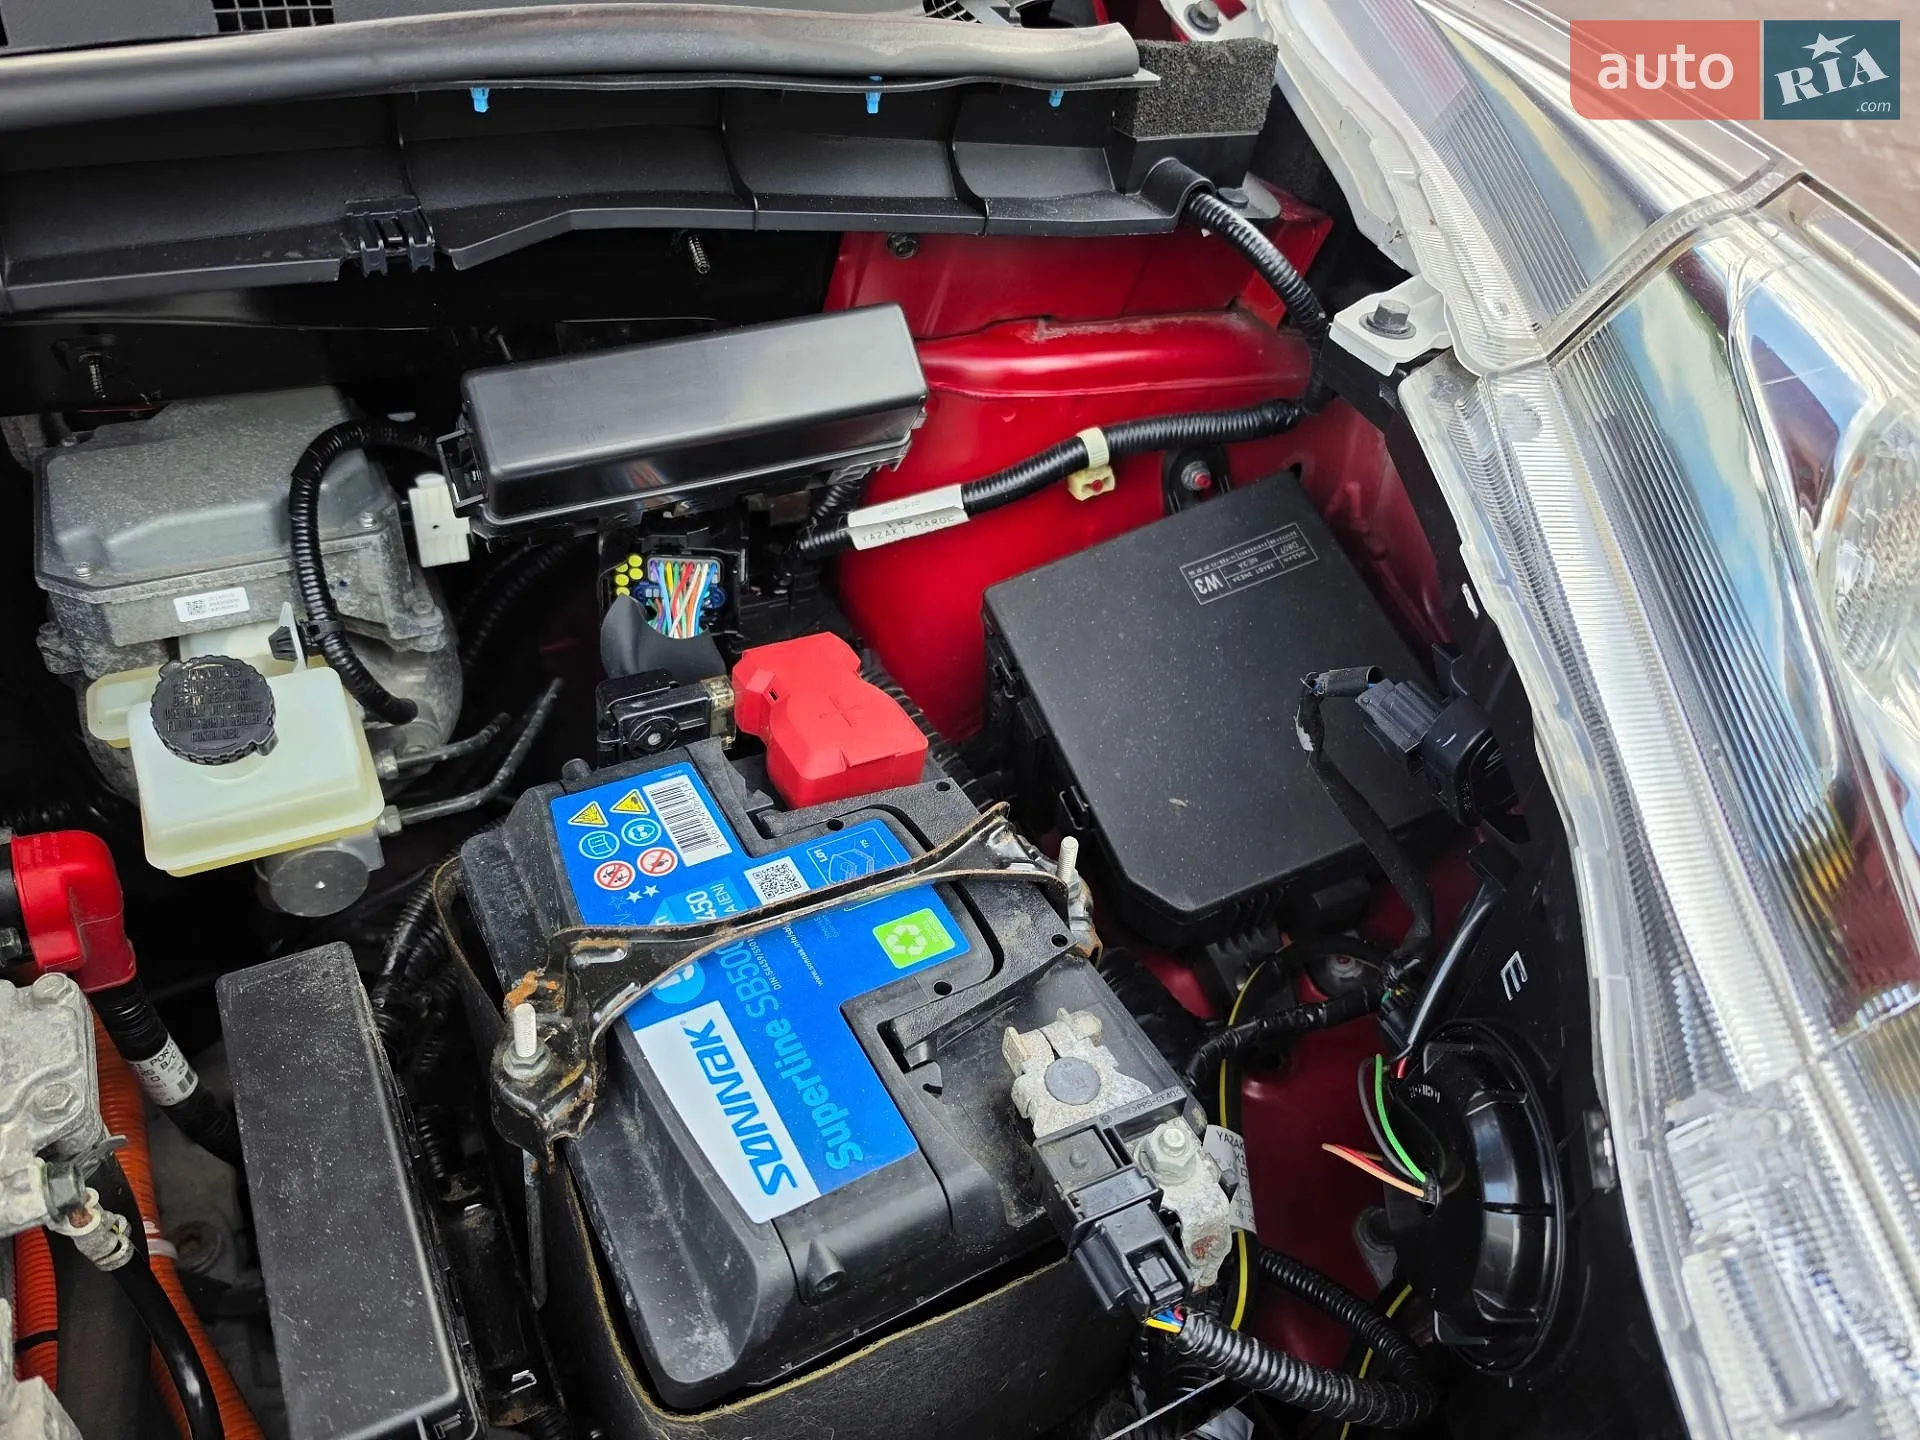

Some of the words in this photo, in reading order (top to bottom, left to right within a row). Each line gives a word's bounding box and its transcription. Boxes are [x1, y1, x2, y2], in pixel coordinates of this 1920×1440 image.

[861, 526, 907, 543] YAZAKI
[914, 514, 955, 530] MAROC
[1194, 572, 1223, 594] W3
[685, 891, 718, 921] 450
[783, 924, 824, 988] www.sonnak.info/sb
[765, 1017, 864, 1170] Superline
[1215, 1129, 1245, 1151] YAZAK
